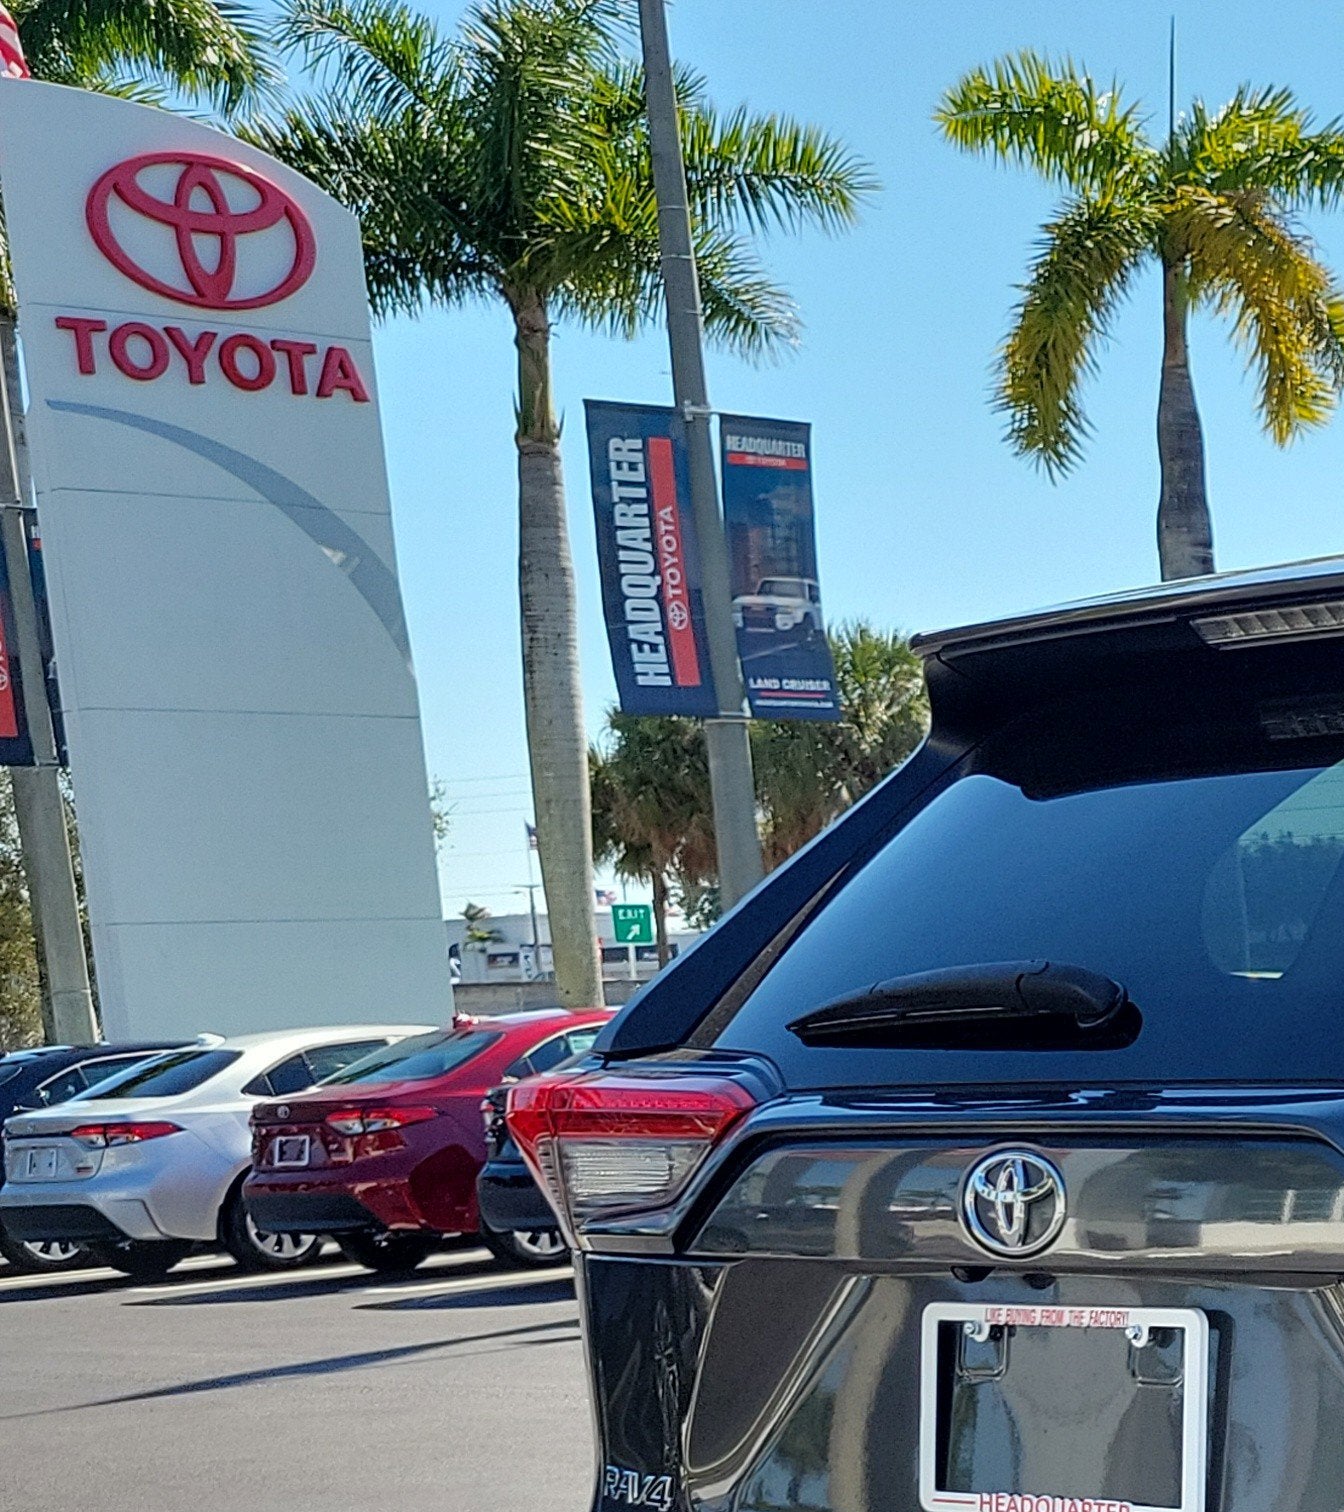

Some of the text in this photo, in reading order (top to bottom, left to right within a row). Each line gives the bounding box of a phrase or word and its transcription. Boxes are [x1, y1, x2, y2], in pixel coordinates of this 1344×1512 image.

[54, 316, 370, 403] TOYOTA
[726, 434, 806, 458] HEADQUARTER
[609, 436, 673, 687] HEADQUARTER
[657, 505, 682, 600] TOYOTA
[748, 677, 781, 689] LAND
[617, 908, 645, 920] EXIT
[985, 1307, 1003, 1323] LIKE
[1006, 1308, 1036, 1325] BUYING
[1040, 1309, 1064, 1325] FROM
[1068, 1310, 1083, 1325] THE
[603, 1464, 674, 1512] RAV4
